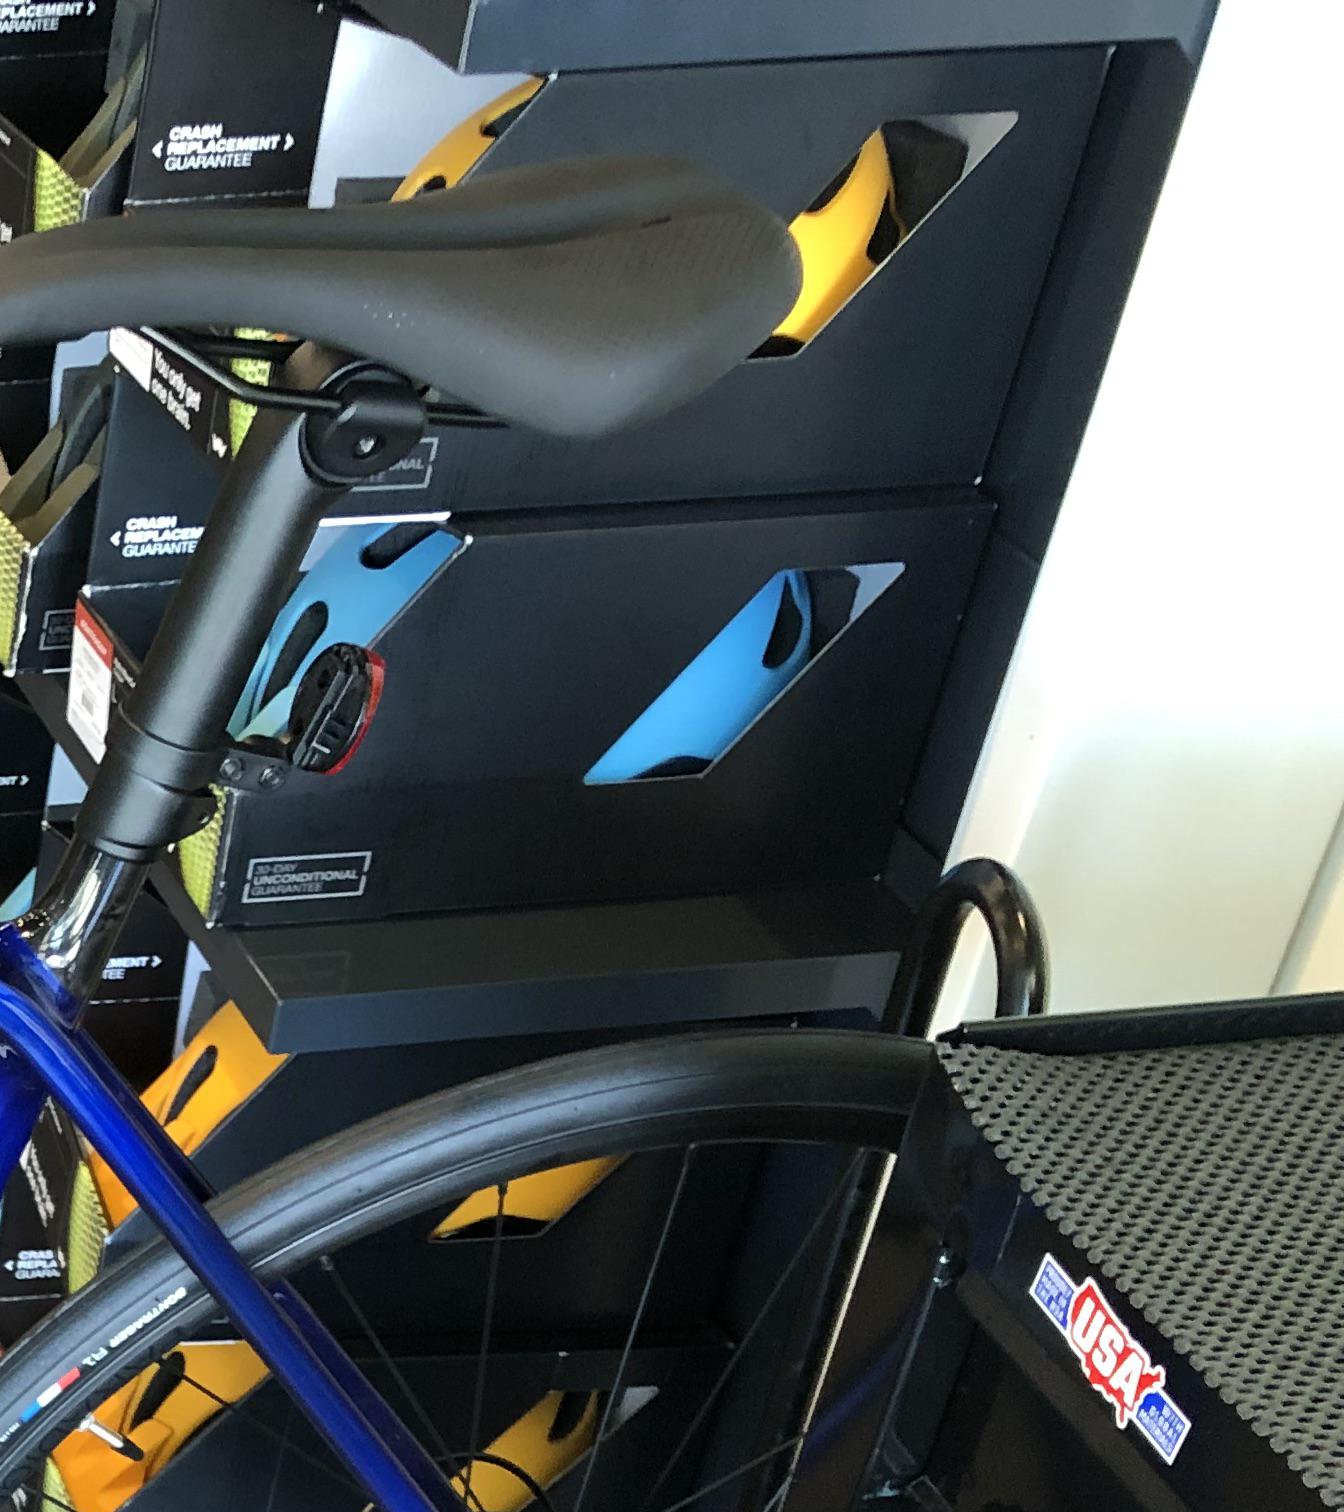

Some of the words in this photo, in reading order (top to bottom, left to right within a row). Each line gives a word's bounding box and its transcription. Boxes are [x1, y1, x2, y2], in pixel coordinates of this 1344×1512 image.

[169, 122, 223, 141] CRASH
[166, 133, 281, 156] REPLACEMENT
[164, 151, 253, 172] GUARANTEE
[126, 515, 178, 531] CRASH
[253, 869, 359, 886] UNCONDITIONAL
[250, 881, 325, 896] GUARANTEE
[1072, 1296, 1146, 1410] USA
